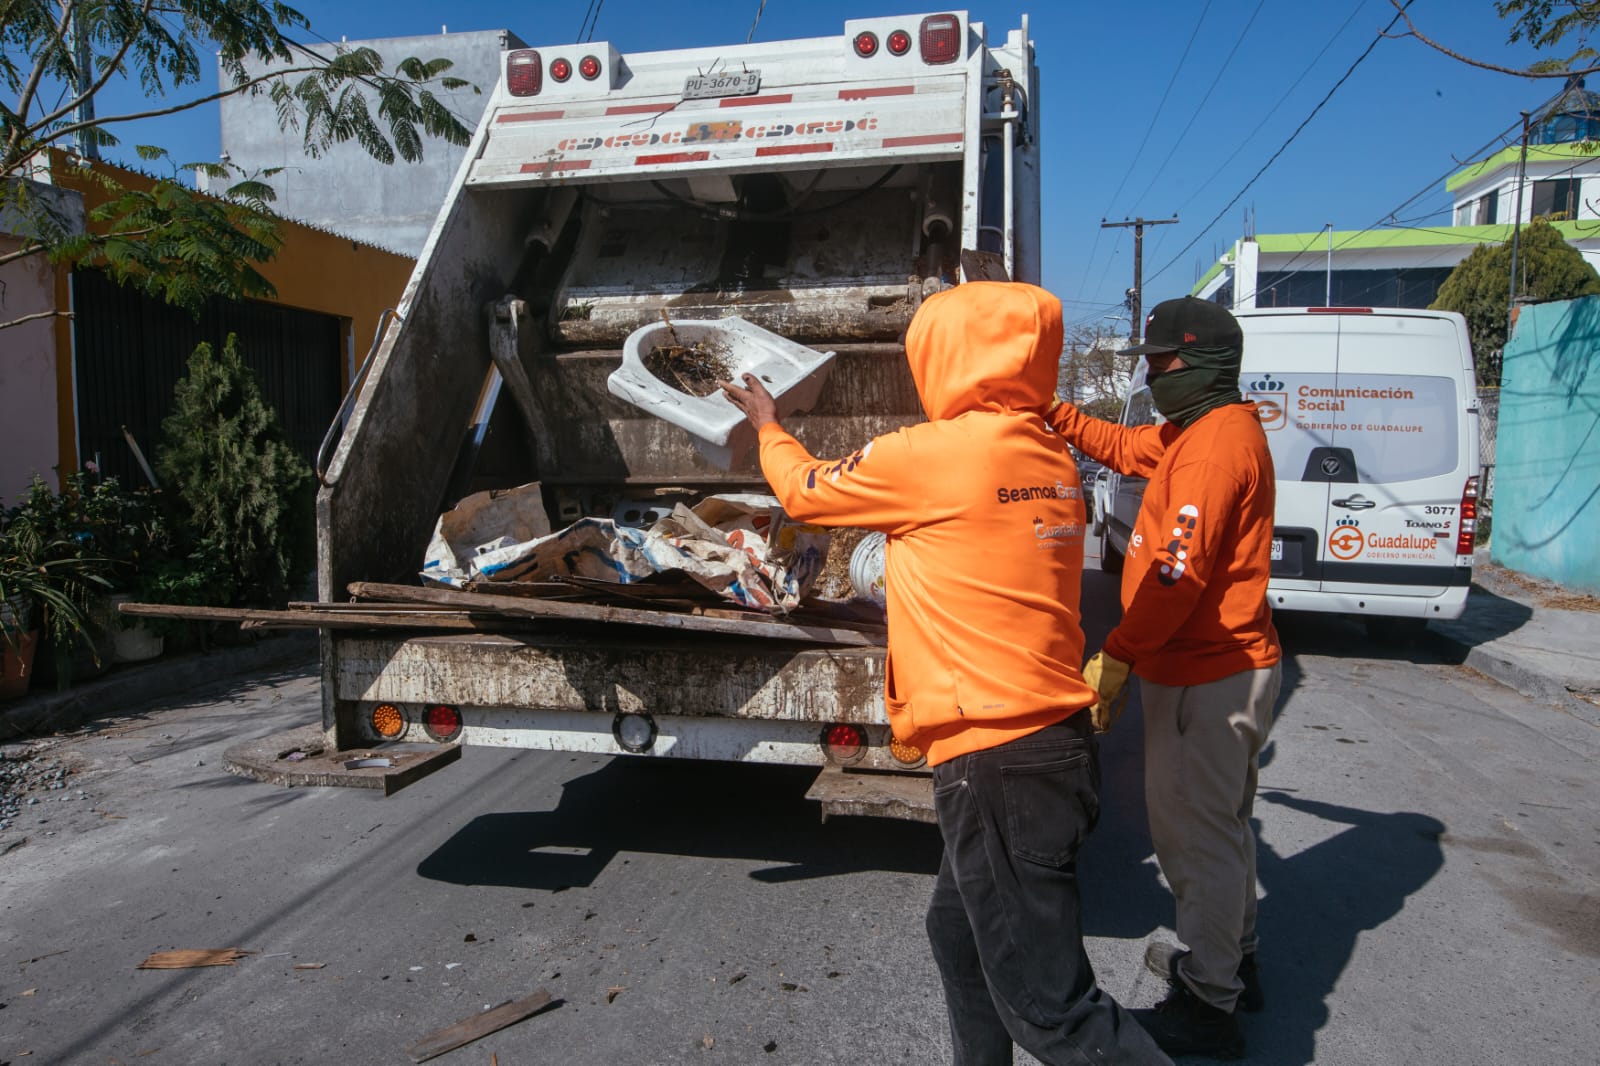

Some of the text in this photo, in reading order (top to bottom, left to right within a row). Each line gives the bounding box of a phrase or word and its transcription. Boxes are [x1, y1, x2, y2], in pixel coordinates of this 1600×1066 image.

[686, 75, 757, 91] PU-3670-B
[1297, 385, 1414, 400] Comunicación
[1297, 399, 1345, 411] Social
[1296, 422, 1424, 433] GOBIERNO DE GUADALUPE
[1424, 505, 1456, 515] 3077
[1367, 532, 1438, 552] Guadalupe
[1366, 551, 1436, 560] GOBIERNO MUNICIPAL
